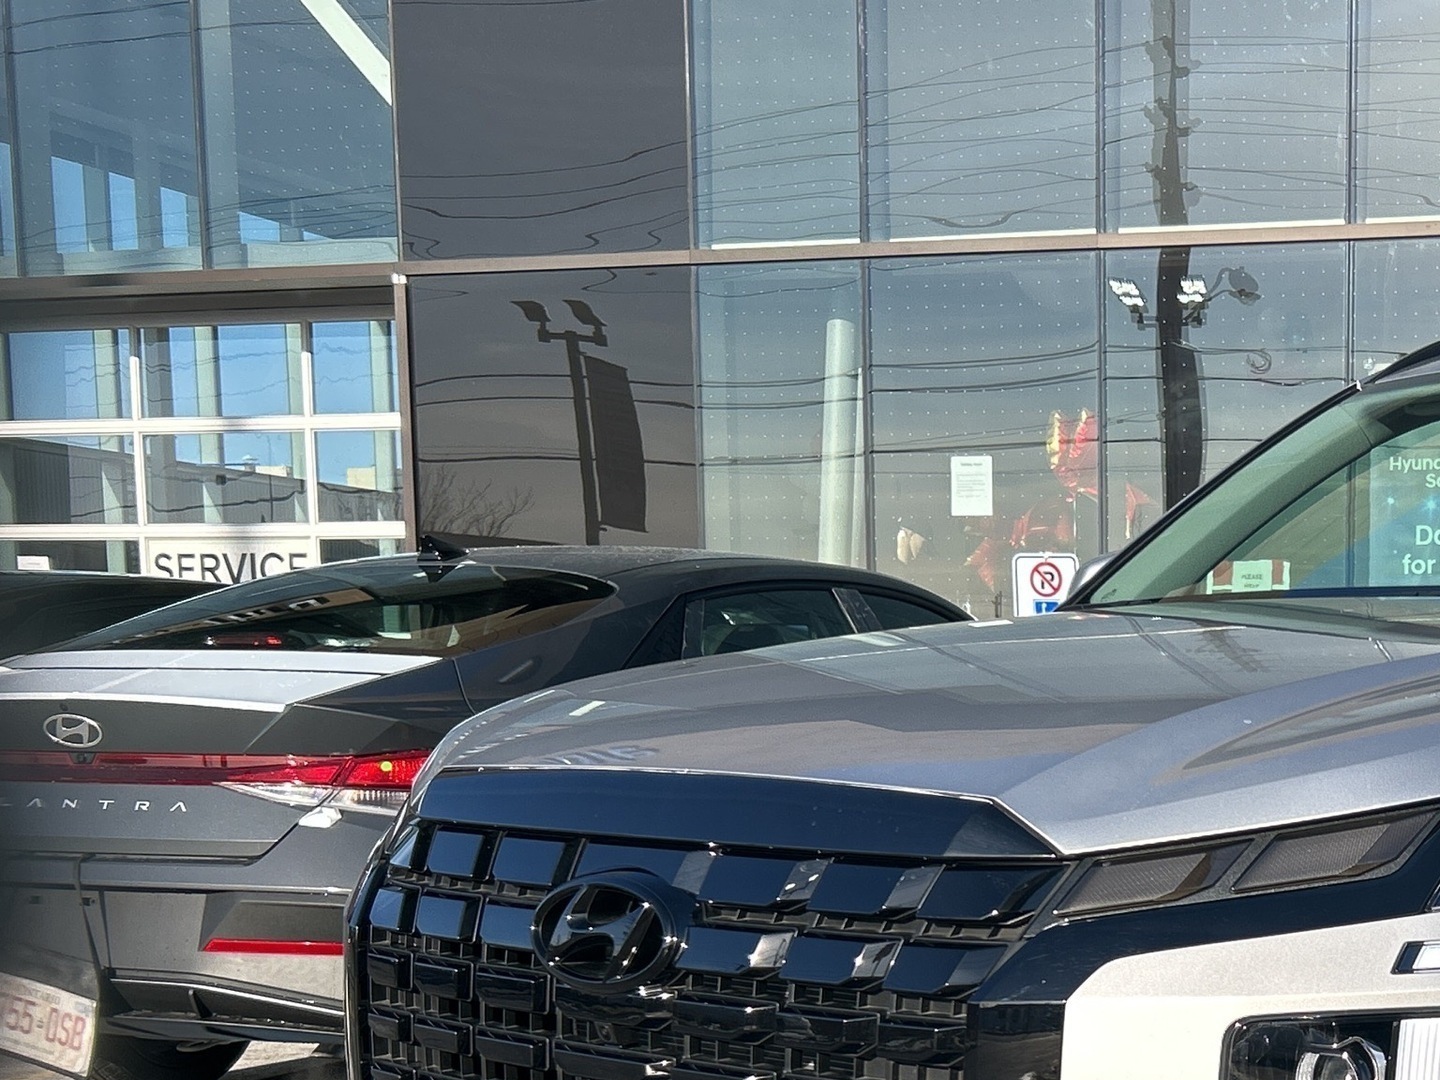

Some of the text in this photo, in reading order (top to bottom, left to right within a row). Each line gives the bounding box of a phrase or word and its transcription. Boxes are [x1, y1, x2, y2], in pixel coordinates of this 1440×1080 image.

[154, 552, 308, 585] SERVICE
[1402, 554, 1436, 575] for
[2, 797, 188, 813] ANTRA
